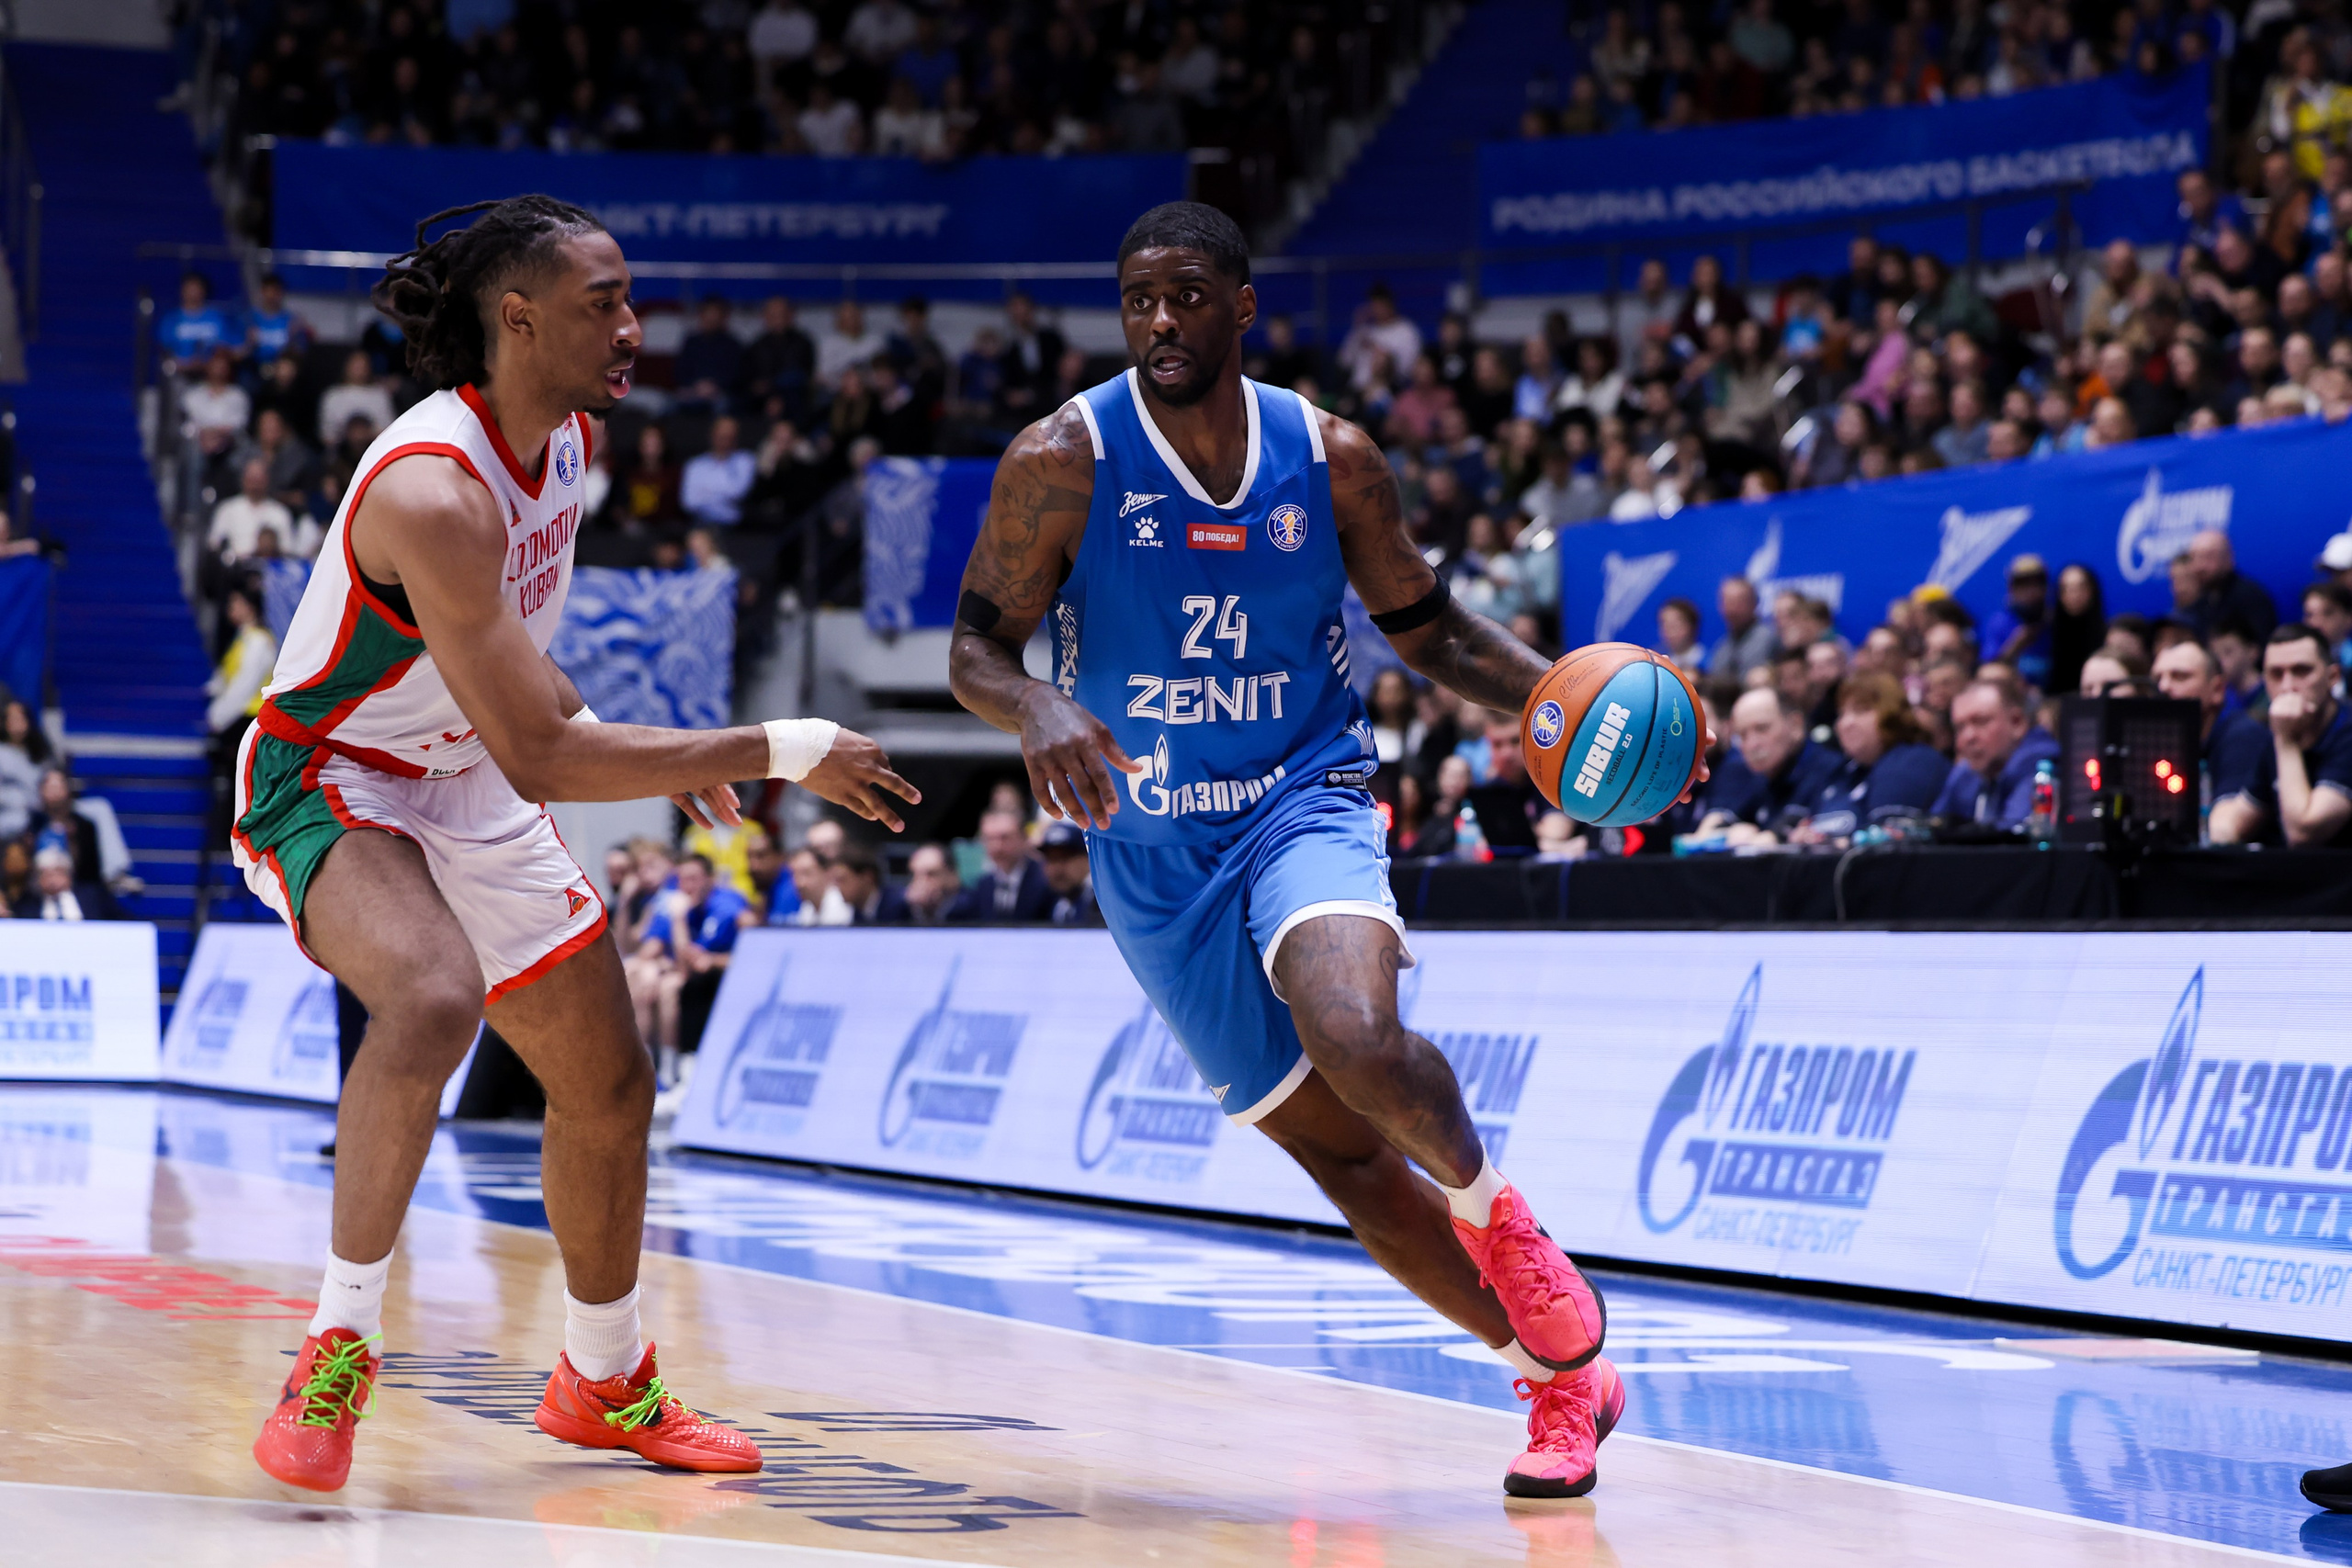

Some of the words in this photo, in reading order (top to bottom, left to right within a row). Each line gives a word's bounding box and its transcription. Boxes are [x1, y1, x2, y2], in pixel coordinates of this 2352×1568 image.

[1128, 538, 1164, 548] KELME
[1193, 530, 1205, 542] 80
[1205, 532, 1239, 544] ПОБЕДА!
[519, 558, 562, 621] KUBAN
[1181, 594, 1248, 660] 24
[1126, 671, 1291, 725] ZENIT
[1574, 702, 1631, 798] SIBUR
[1622, 732, 1634, 749] 2.0
[1648, 770, 1657, 786] LIFE
[1658, 727, 1668, 759] PLASTIC
[1727, 1043, 1918, 1141] ГАЗПРОМ
[2170, 1059, 2352, 1172] ГАЗПРО
[1714, 1150, 1877, 1201] ТРАНСГАЗ
[1693, 1204, 1864, 1257] САНКТ-ПЕТЕРБУРГ
[2160, 1183, 2352, 1242] ТРАНСГА
